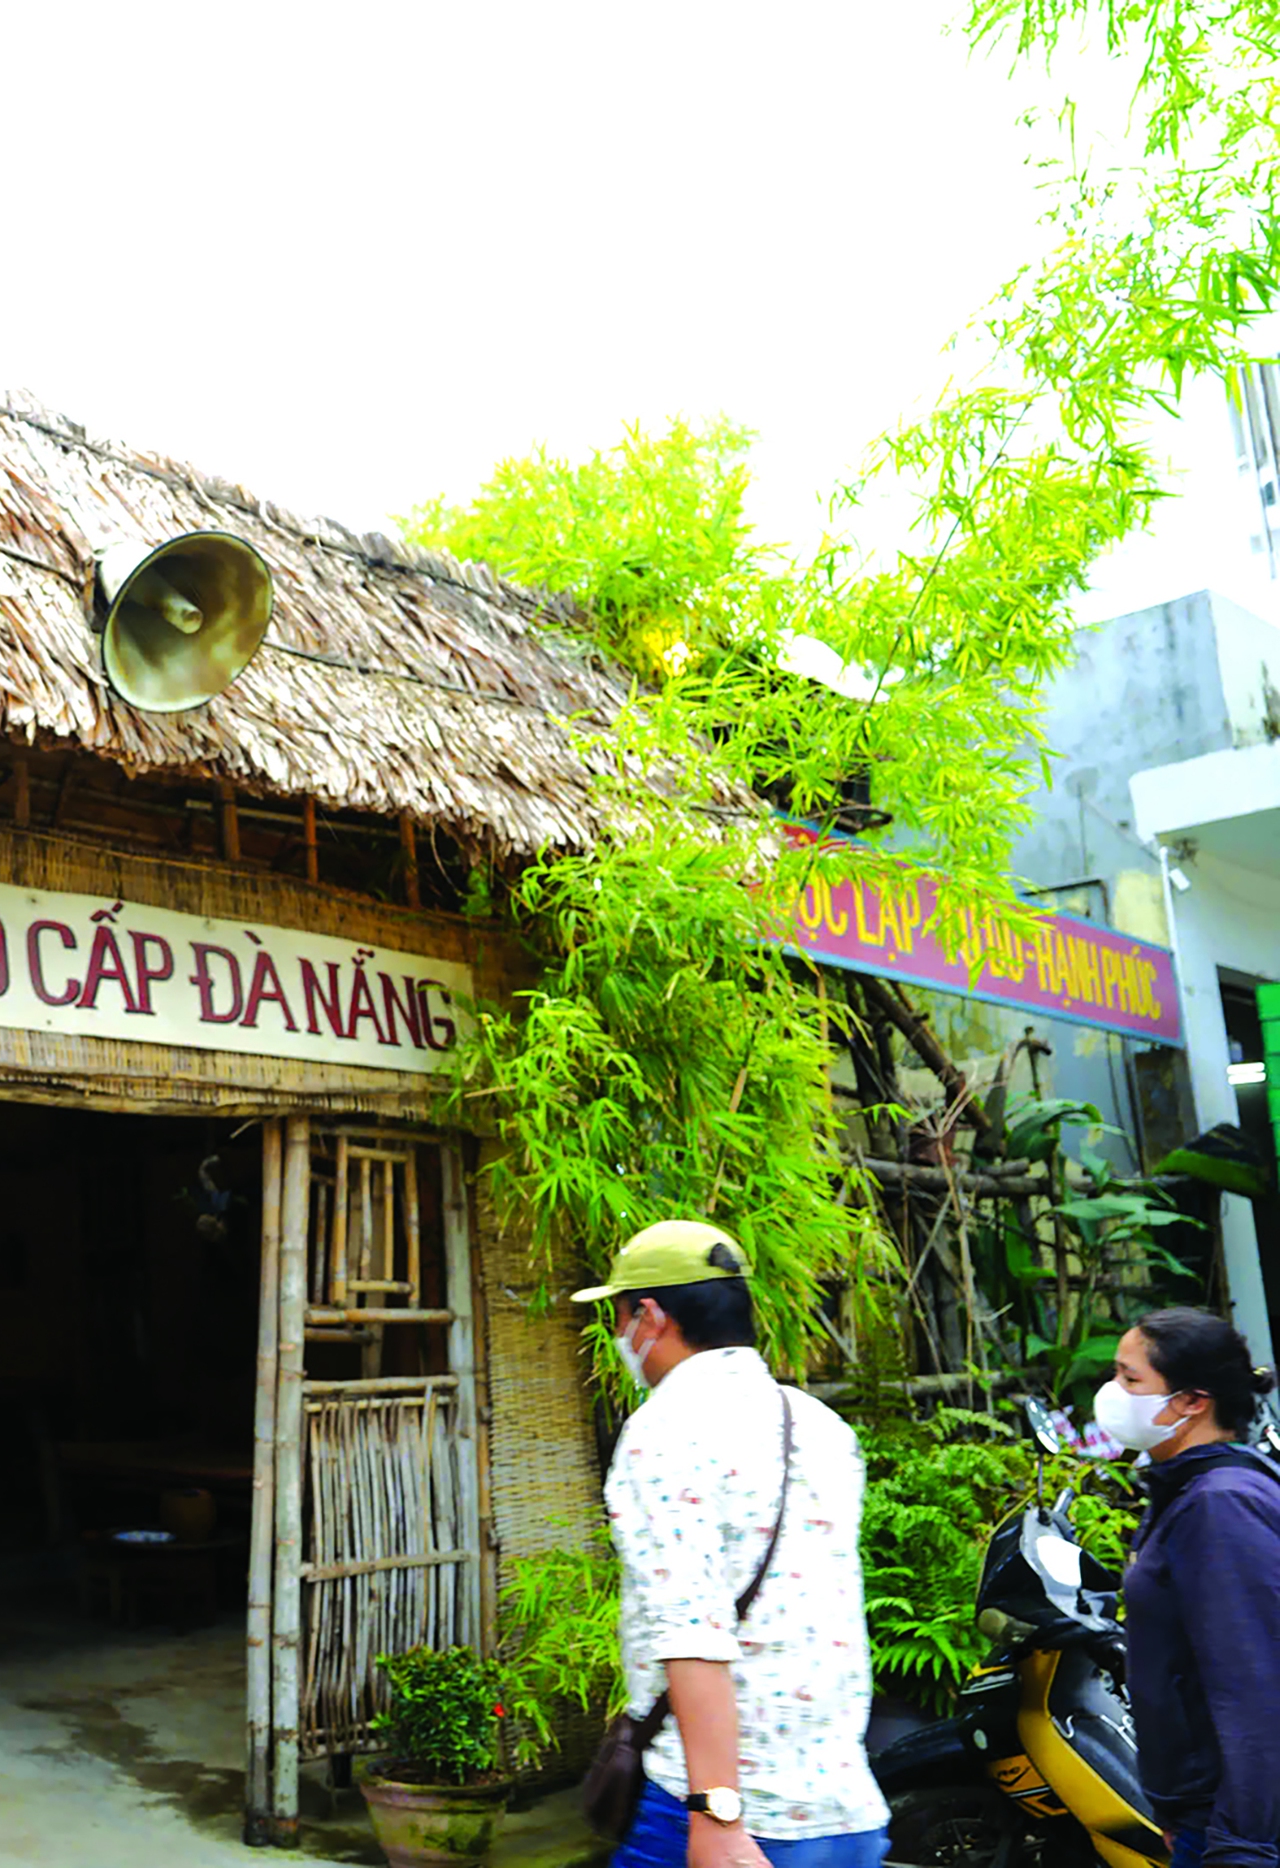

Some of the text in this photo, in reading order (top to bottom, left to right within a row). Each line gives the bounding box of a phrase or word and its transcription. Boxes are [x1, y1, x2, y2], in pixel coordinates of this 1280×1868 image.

[27, 901, 174, 1015] CẤP
[190, 930, 299, 1033] ĐÀ
[297, 947, 456, 1051] NẴNG
[1101, 945, 1161, 1020] PHÚC
